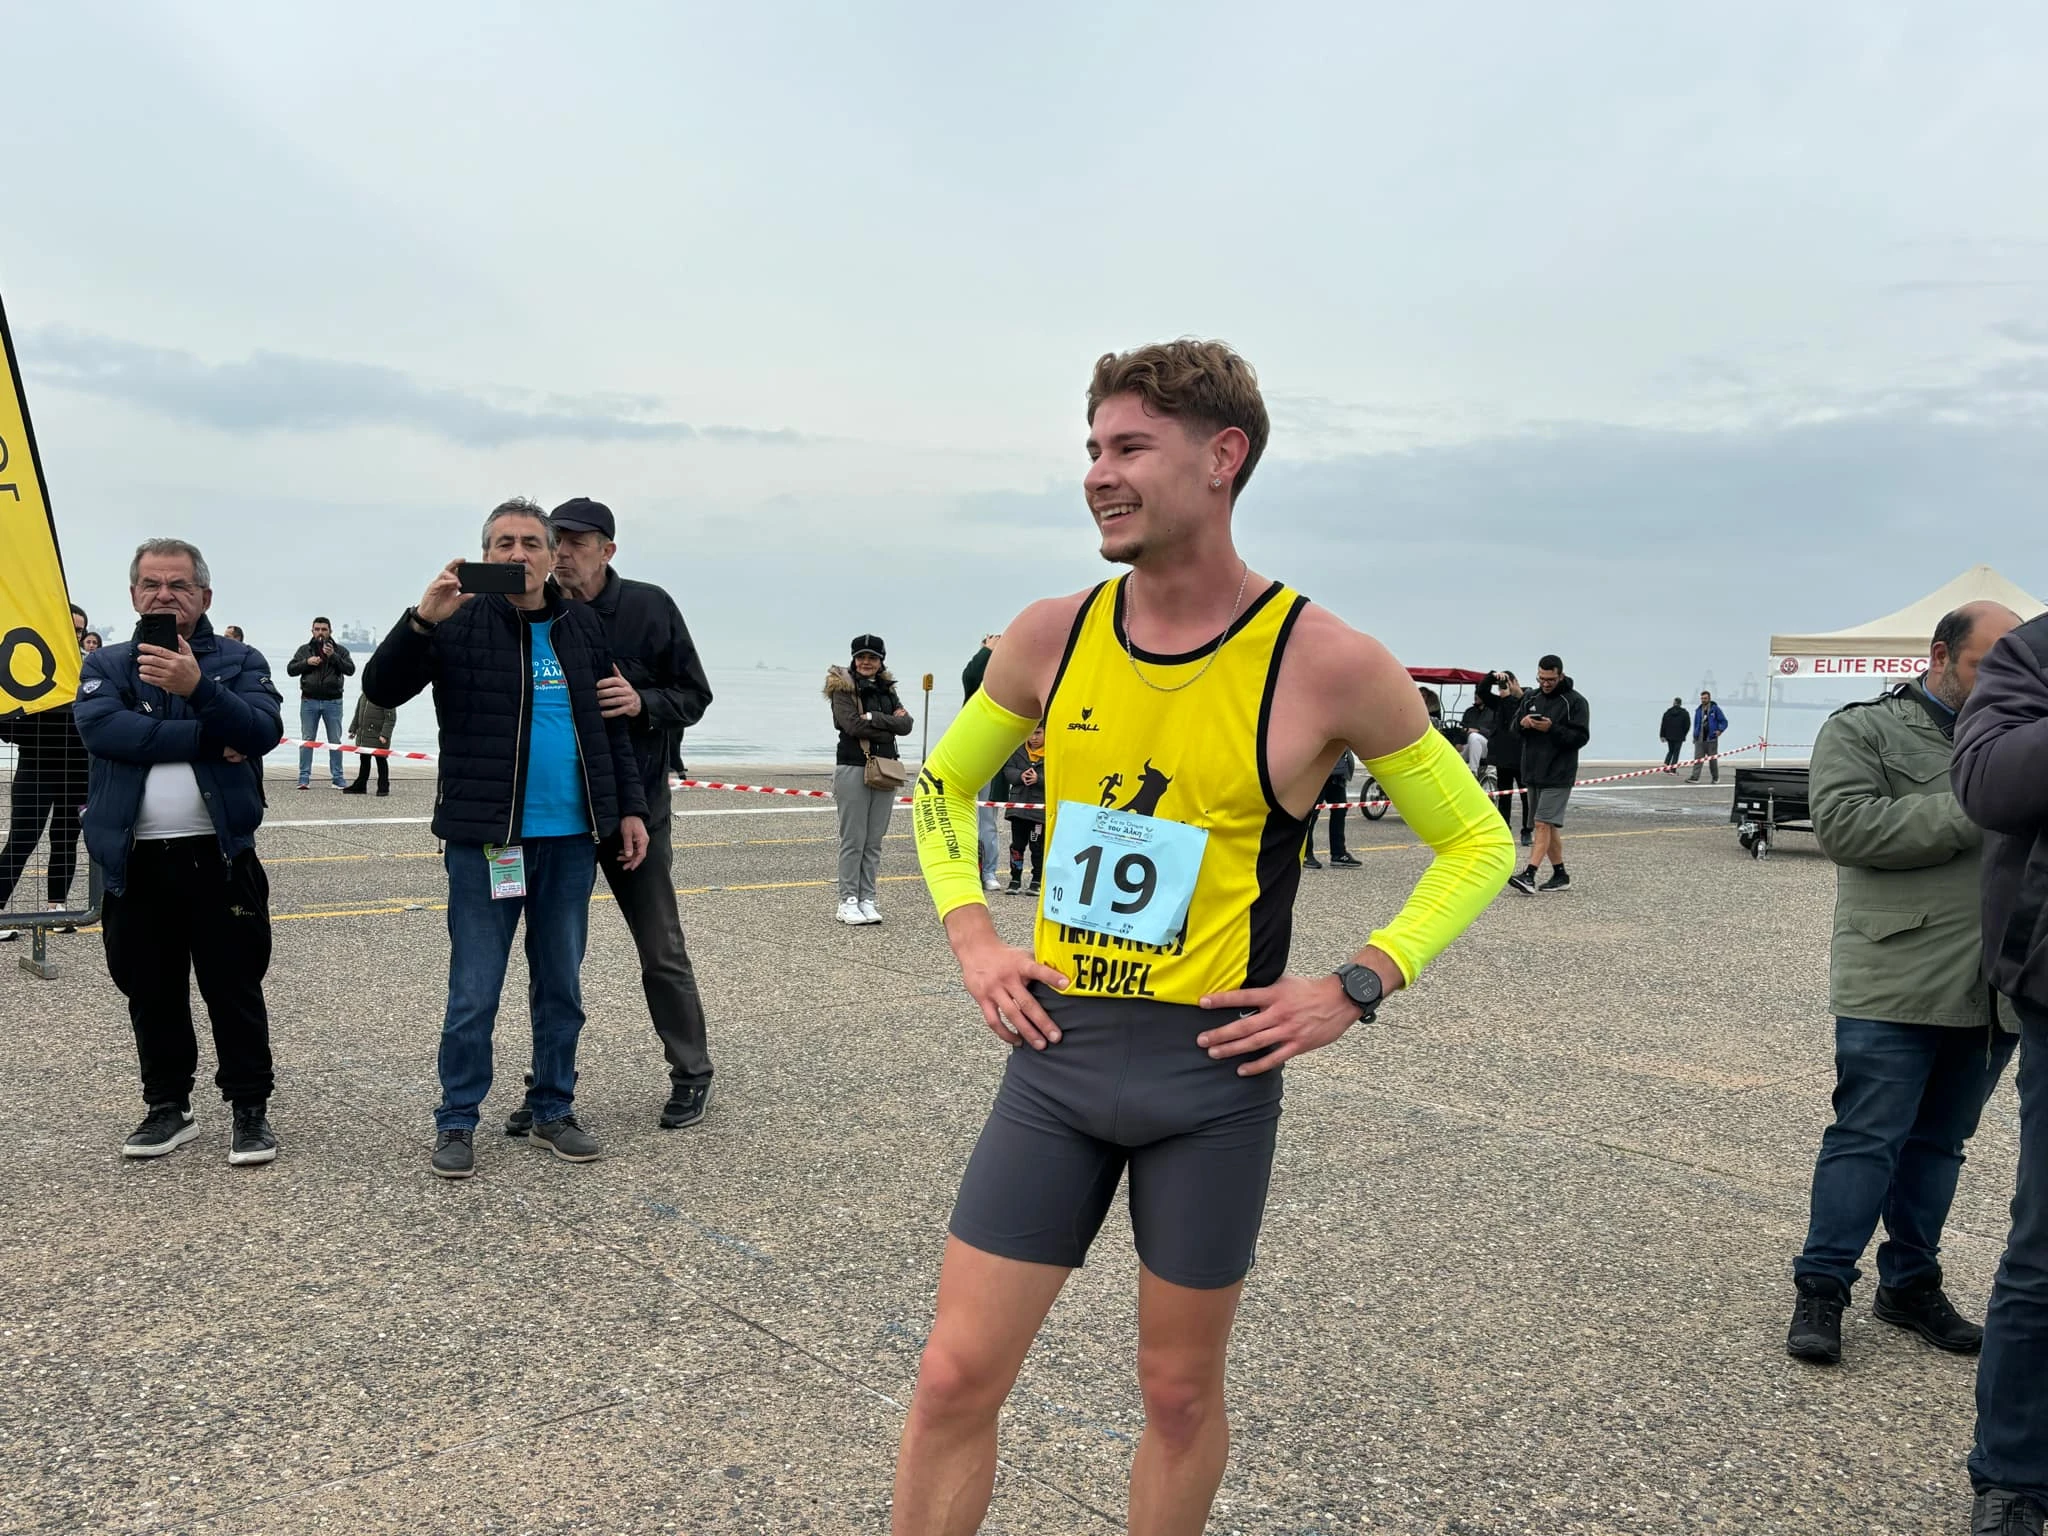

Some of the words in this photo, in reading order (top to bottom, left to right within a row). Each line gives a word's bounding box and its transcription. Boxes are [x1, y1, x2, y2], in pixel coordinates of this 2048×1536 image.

[1814, 658, 1867, 673] ELITE
[1873, 658, 1928, 673] RESC
[1066, 722, 1100, 732] SPALL
[921, 797, 936, 832] ZAMORA
[934, 797, 946, 816] CLUB
[938, 816, 961, 859] ATLETISMO
[1073, 844, 1158, 915] 19
[1052, 885, 1064, 902] 10
[1072, 954, 1155, 997] TERUEL
